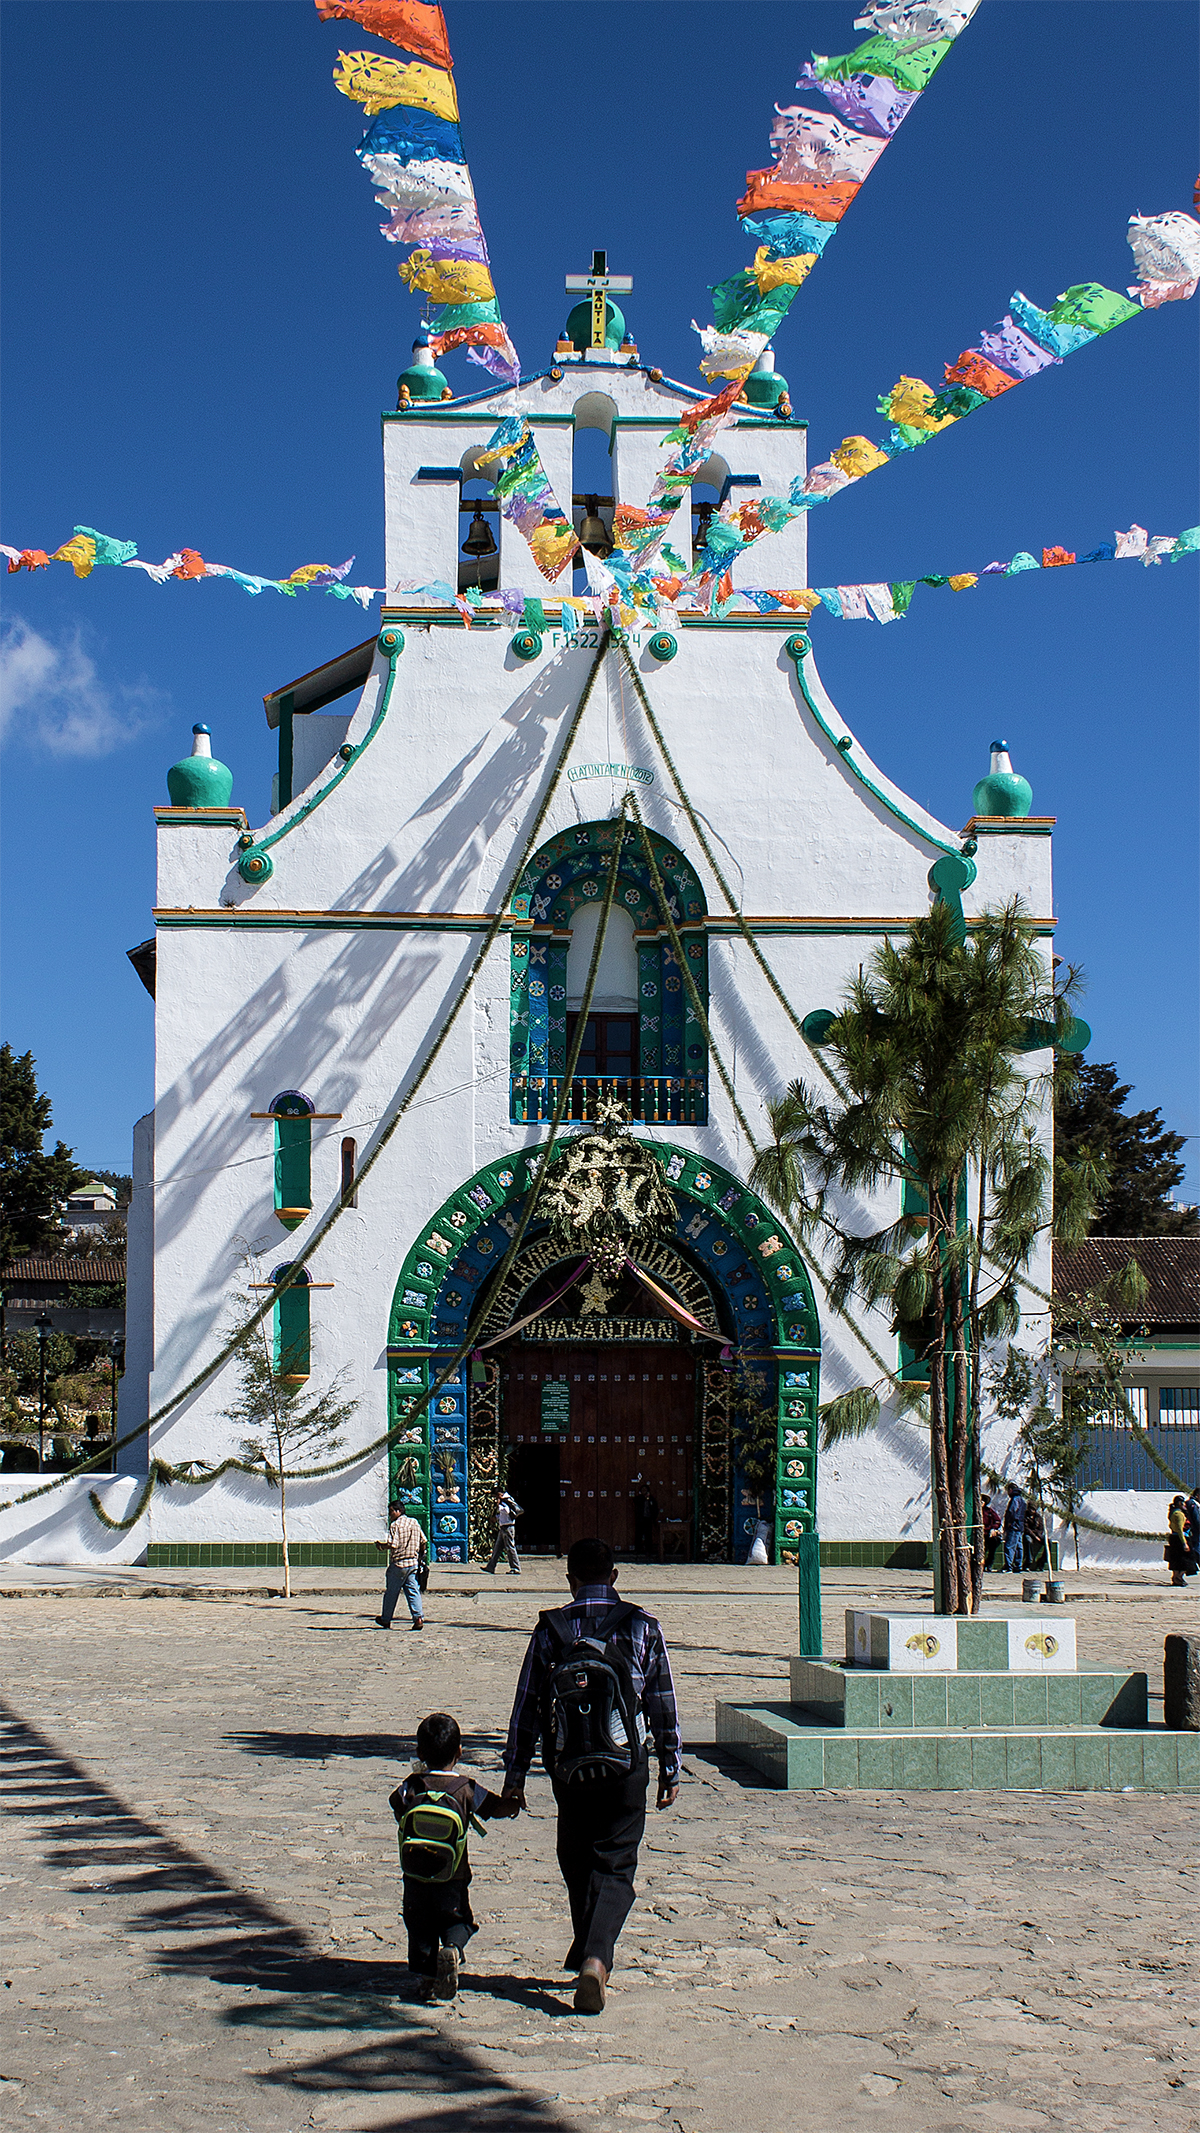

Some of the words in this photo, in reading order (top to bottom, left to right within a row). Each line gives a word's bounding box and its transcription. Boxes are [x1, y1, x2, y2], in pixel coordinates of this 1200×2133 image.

[525, 1320, 569, 1339] VIVA
[569, 1320, 613, 1339] SAN
[614, 1320, 673, 1339] JUAN
